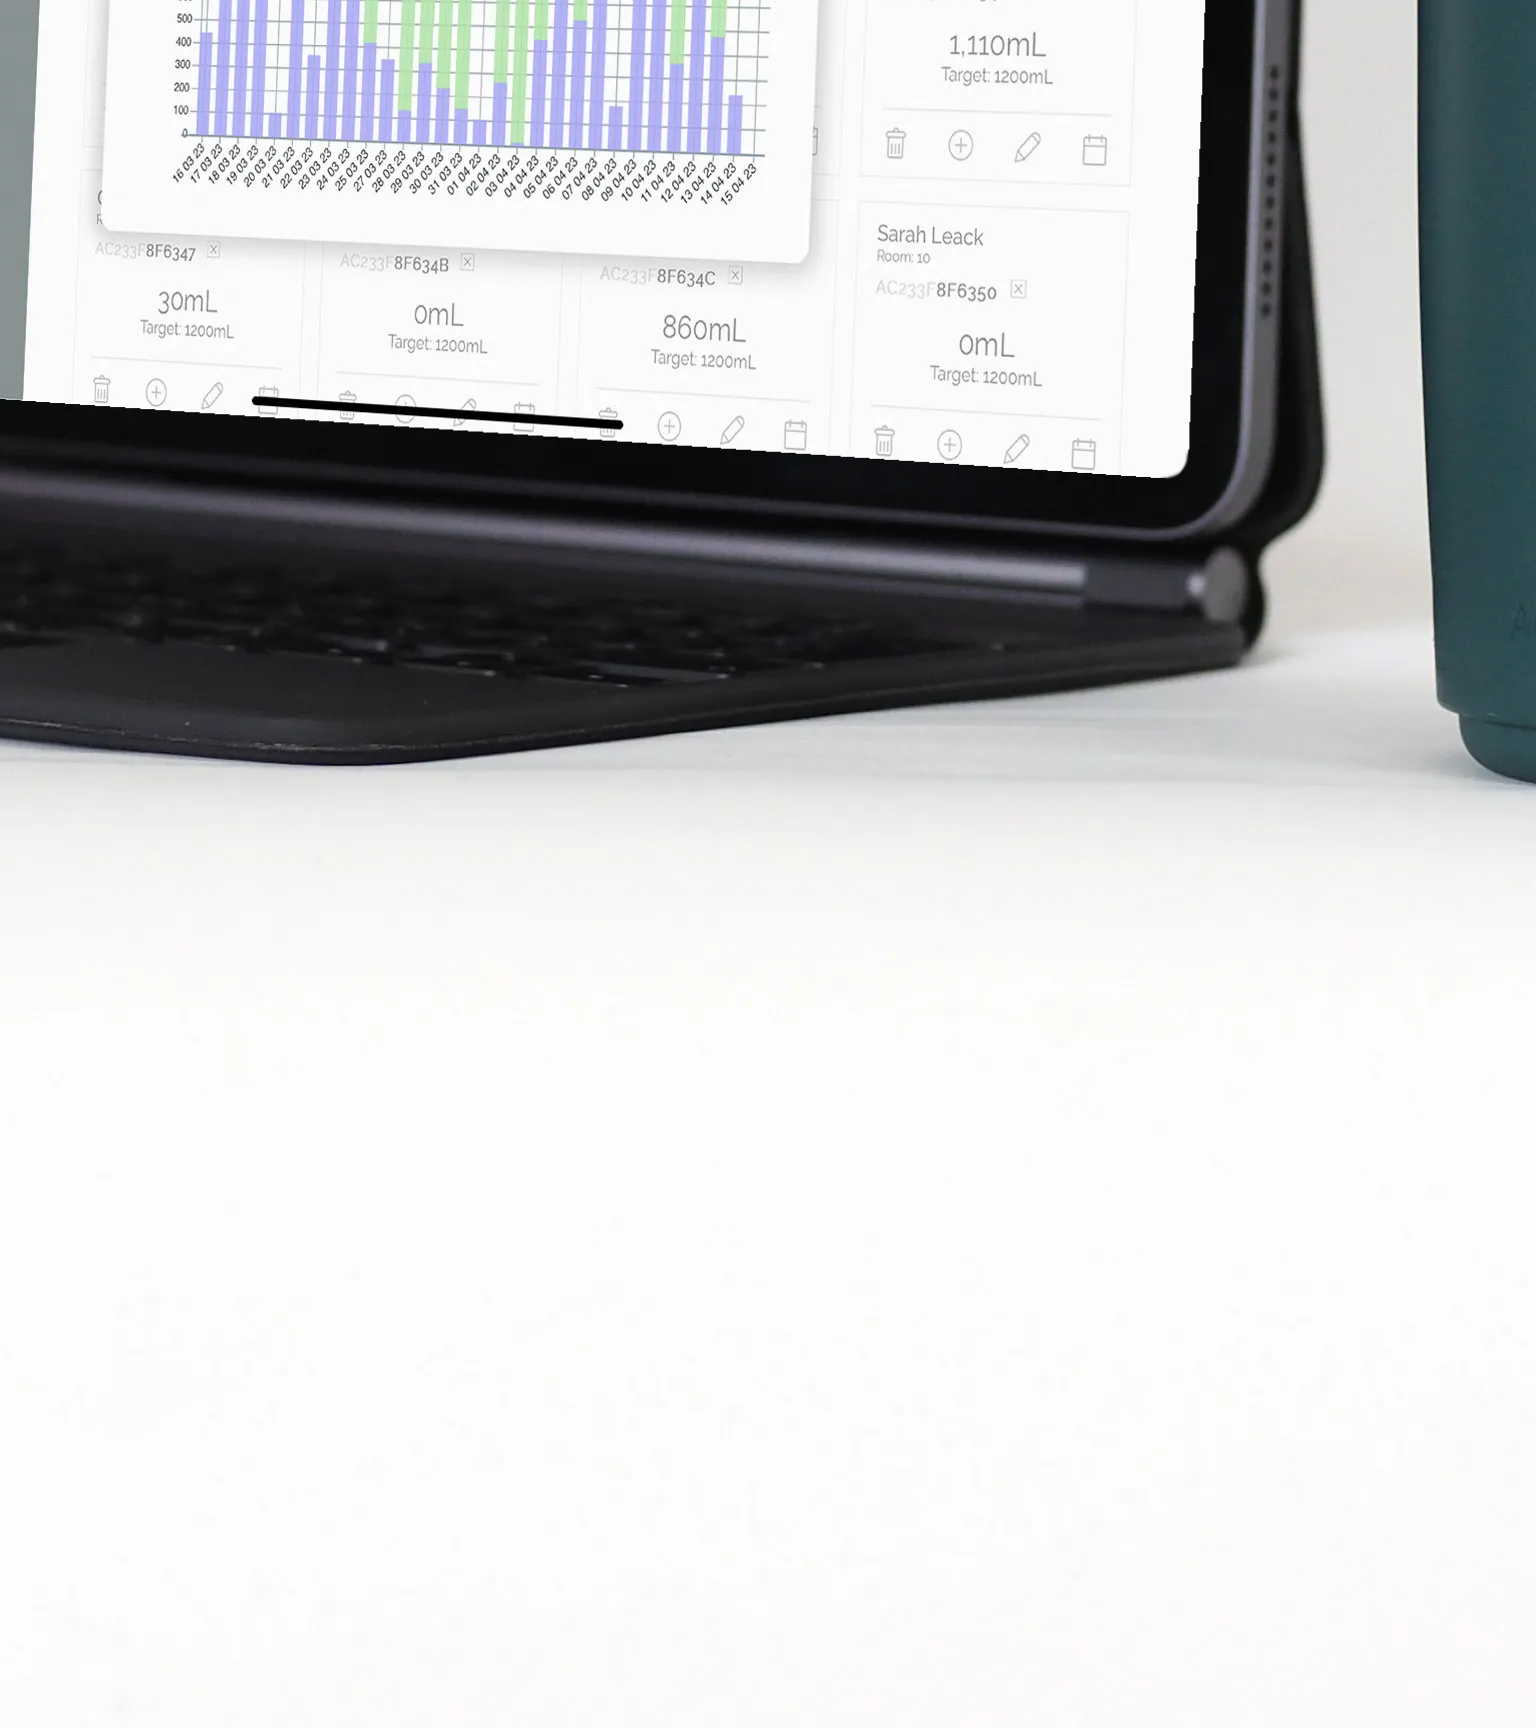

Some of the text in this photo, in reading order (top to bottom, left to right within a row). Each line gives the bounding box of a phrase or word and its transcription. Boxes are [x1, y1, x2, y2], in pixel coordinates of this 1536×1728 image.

[177, 13, 192, 23] 500
[176, 37, 191, 46] 400
[950, 32, 1046, 57] 1,110mL
[175, 59, 191, 69] 300
[941, 67, 1053, 86] Target: 1200mL
[174, 82, 190, 92] 200
[174, 105, 189, 115] 100
[173, 143, 205, 182] 16 03 23
[190, 143, 223, 183] 17 03 23
[226, 145, 258, 185] 19 03 23
[244, 145, 276, 188] 20 03 23
[280, 147, 313, 189] 22 03 23
[298, 148, 332, 190] 23 03 23
[335, 149, 368, 192] 25 03 23
[353, 150, 387, 192] 27 03 23
[390, 151, 425, 194] 29 03 23
[447, 153, 482, 195] 01 04 23
[466, 154, 501, 196] 02 04 23
[504, 155, 539, 198] 04 04 23
[523, 156, 558, 198] 05 04 23
[562, 157, 597, 200] 07 04 23
[621, 160, 656, 201] 10 04 23
[641, 160, 676, 202] 11 04 23
[681, 162, 716, 204] 13 04 23
[700, 162, 736, 204] 14 04 23
[720, 163, 756, 205] 15 04 23
[878, 224, 983, 246] Sarah Leack
[877, 249, 931, 264] Room: 10
[158, 290, 217, 314] 30mL
[415, 303, 463, 326] 0mL
[141, 320, 234, 338] Target: 1200mL
[388, 334, 487, 354] Target: 1200mL
[663, 315, 746, 342] 860mL
[960, 332, 1015, 357] 0mL
[651, 349, 756, 369] Target: 1200mL
[930, 365, 1042, 386] Target: 1200mL
